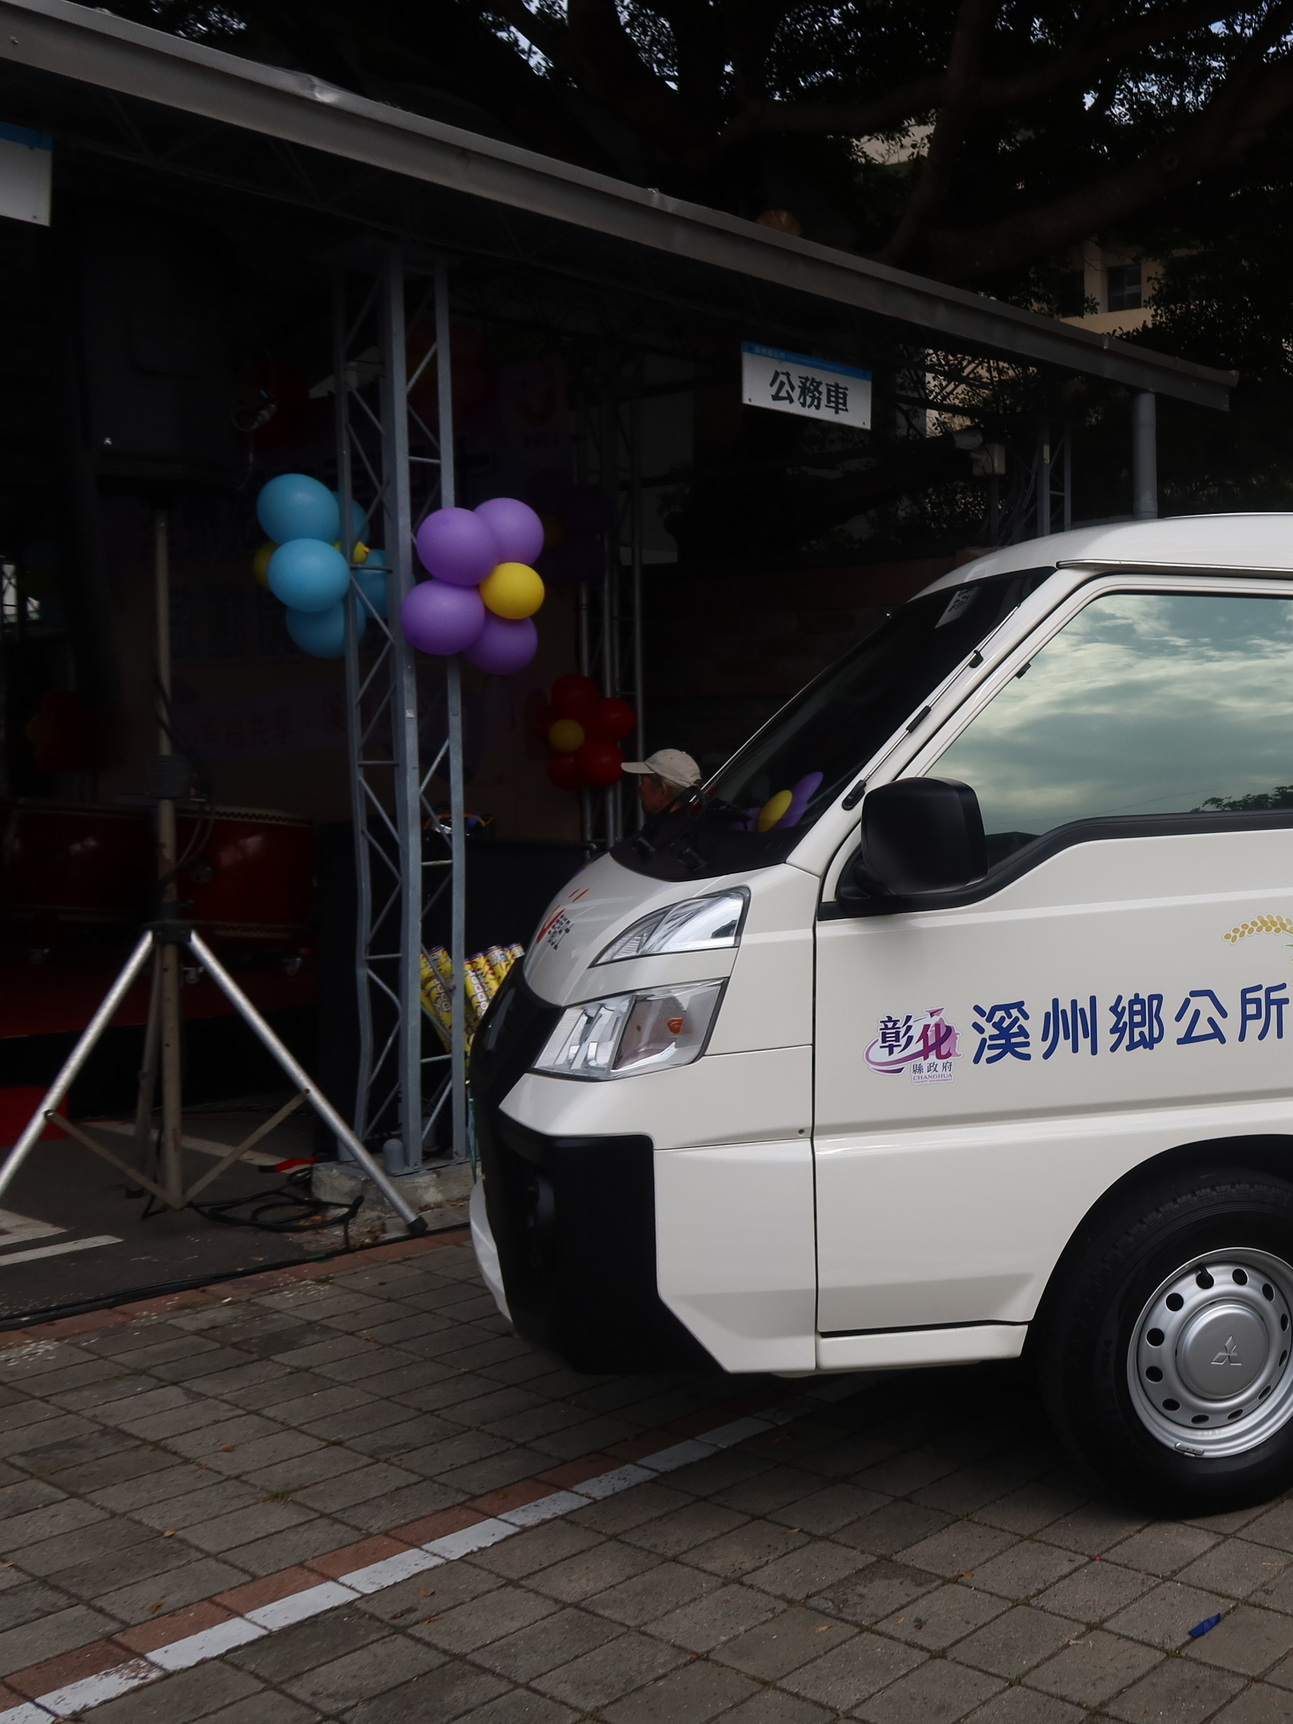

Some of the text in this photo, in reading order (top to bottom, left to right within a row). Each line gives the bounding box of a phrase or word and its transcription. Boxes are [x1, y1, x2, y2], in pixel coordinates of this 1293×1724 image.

[769, 369, 849, 415] 公務車
[879, 1014, 953, 1061] 彰化
[971, 982, 1290, 1064] 溪州鄉公所
[912, 1061, 953, 1074] 縣政府
